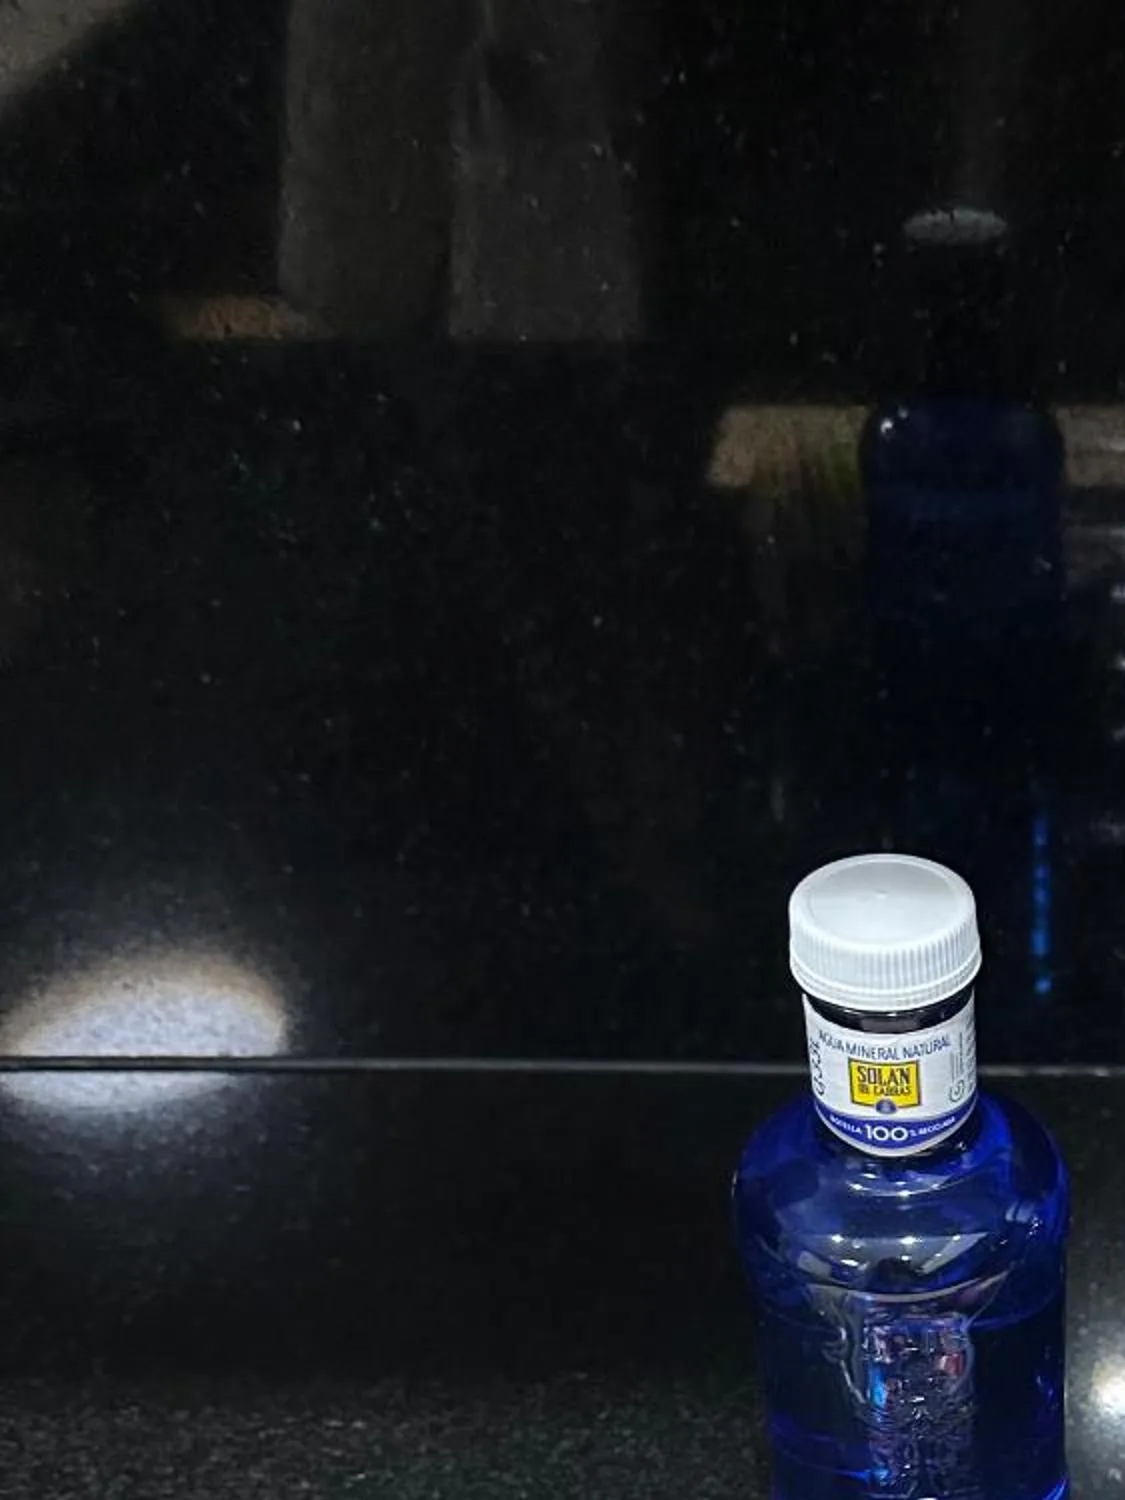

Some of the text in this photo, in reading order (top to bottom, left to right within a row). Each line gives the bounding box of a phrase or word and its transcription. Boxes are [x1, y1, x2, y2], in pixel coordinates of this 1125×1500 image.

[846, 1042, 900, 1060] MINERAL
[903, 1035, 952, 1058] NATURAL
[865, 1124, 909, 1141] 100
